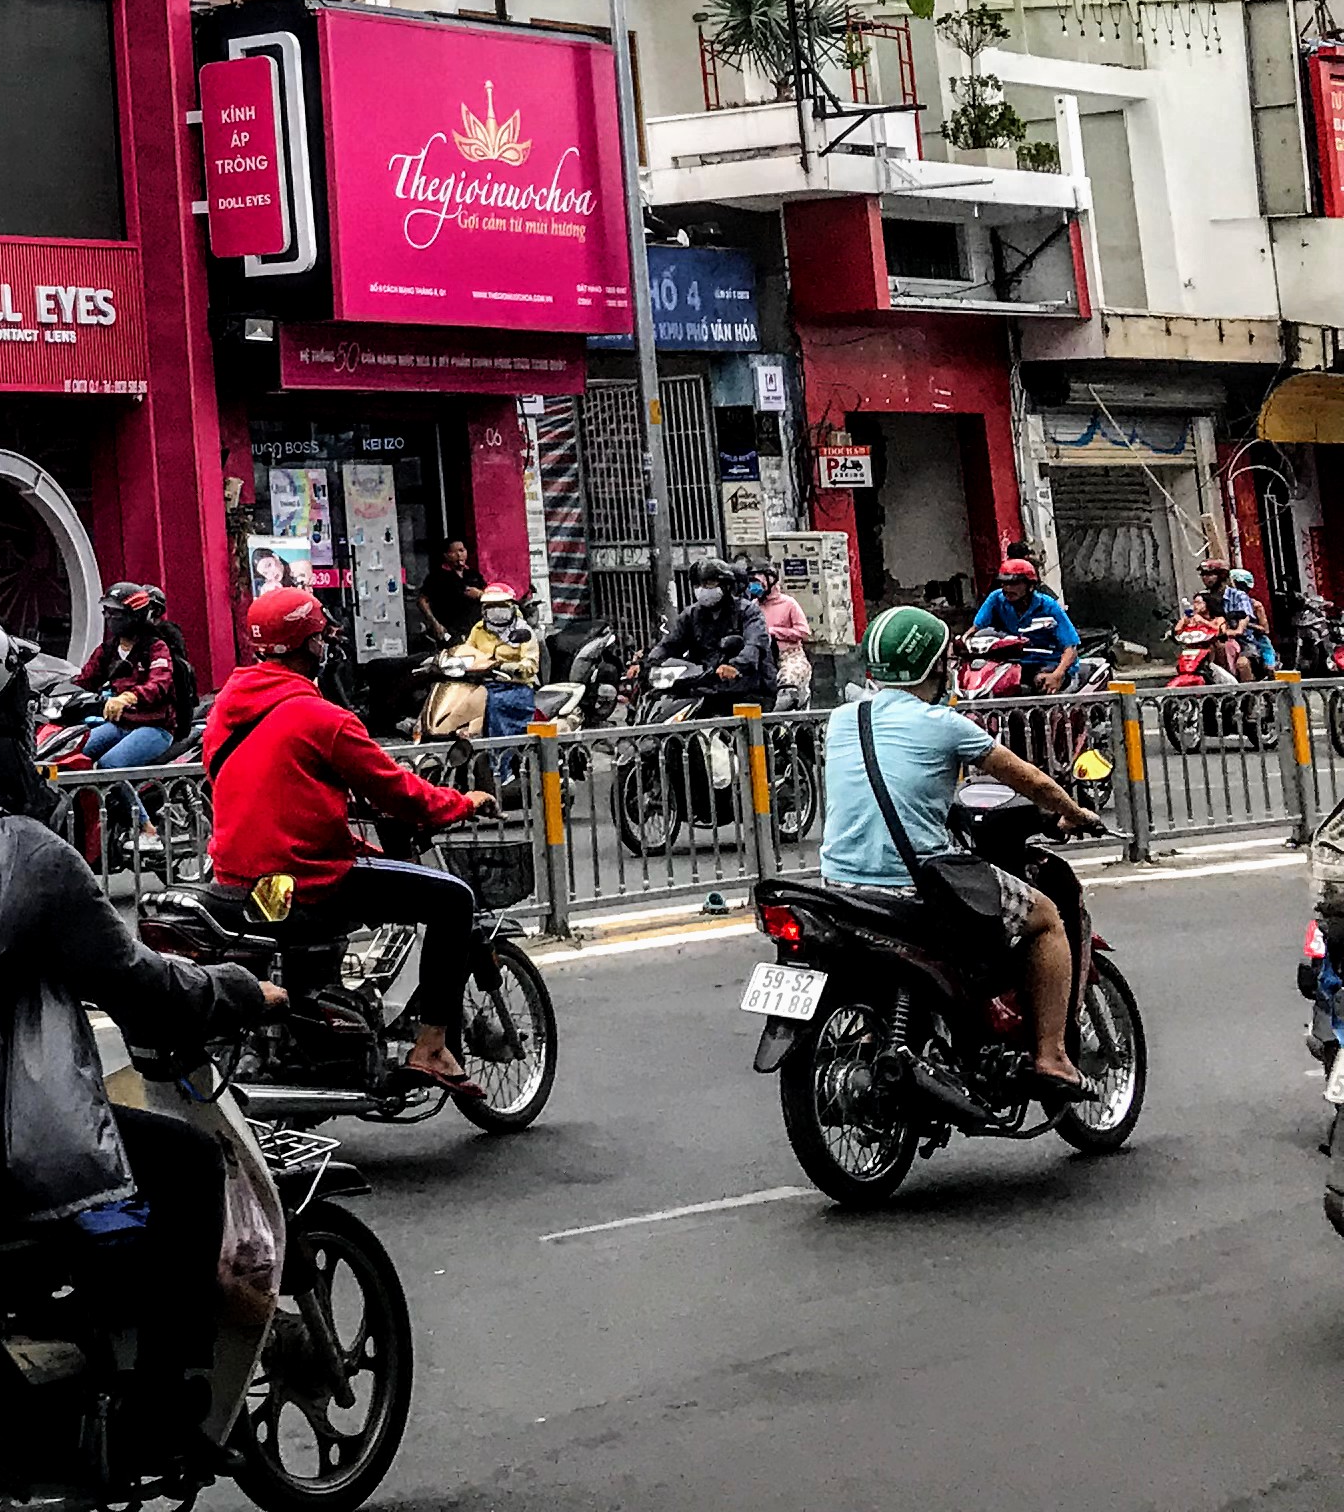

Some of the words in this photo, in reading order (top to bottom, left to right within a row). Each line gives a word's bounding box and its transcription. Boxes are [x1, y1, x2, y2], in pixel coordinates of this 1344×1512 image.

[221, 101, 256, 124] KÍNH
[230, 126, 251, 149] ÁP
[215, 154, 269, 175] TRÒNG
[388, 132, 598, 250] Thegioinuochoa
[651, 265, 678, 312] HỐ
[687, 280, 702, 312] 4
[35, 285, 116, 326] EYES
[285, 440, 320, 455] BOSS
[362, 437, 405, 451] KENZO
